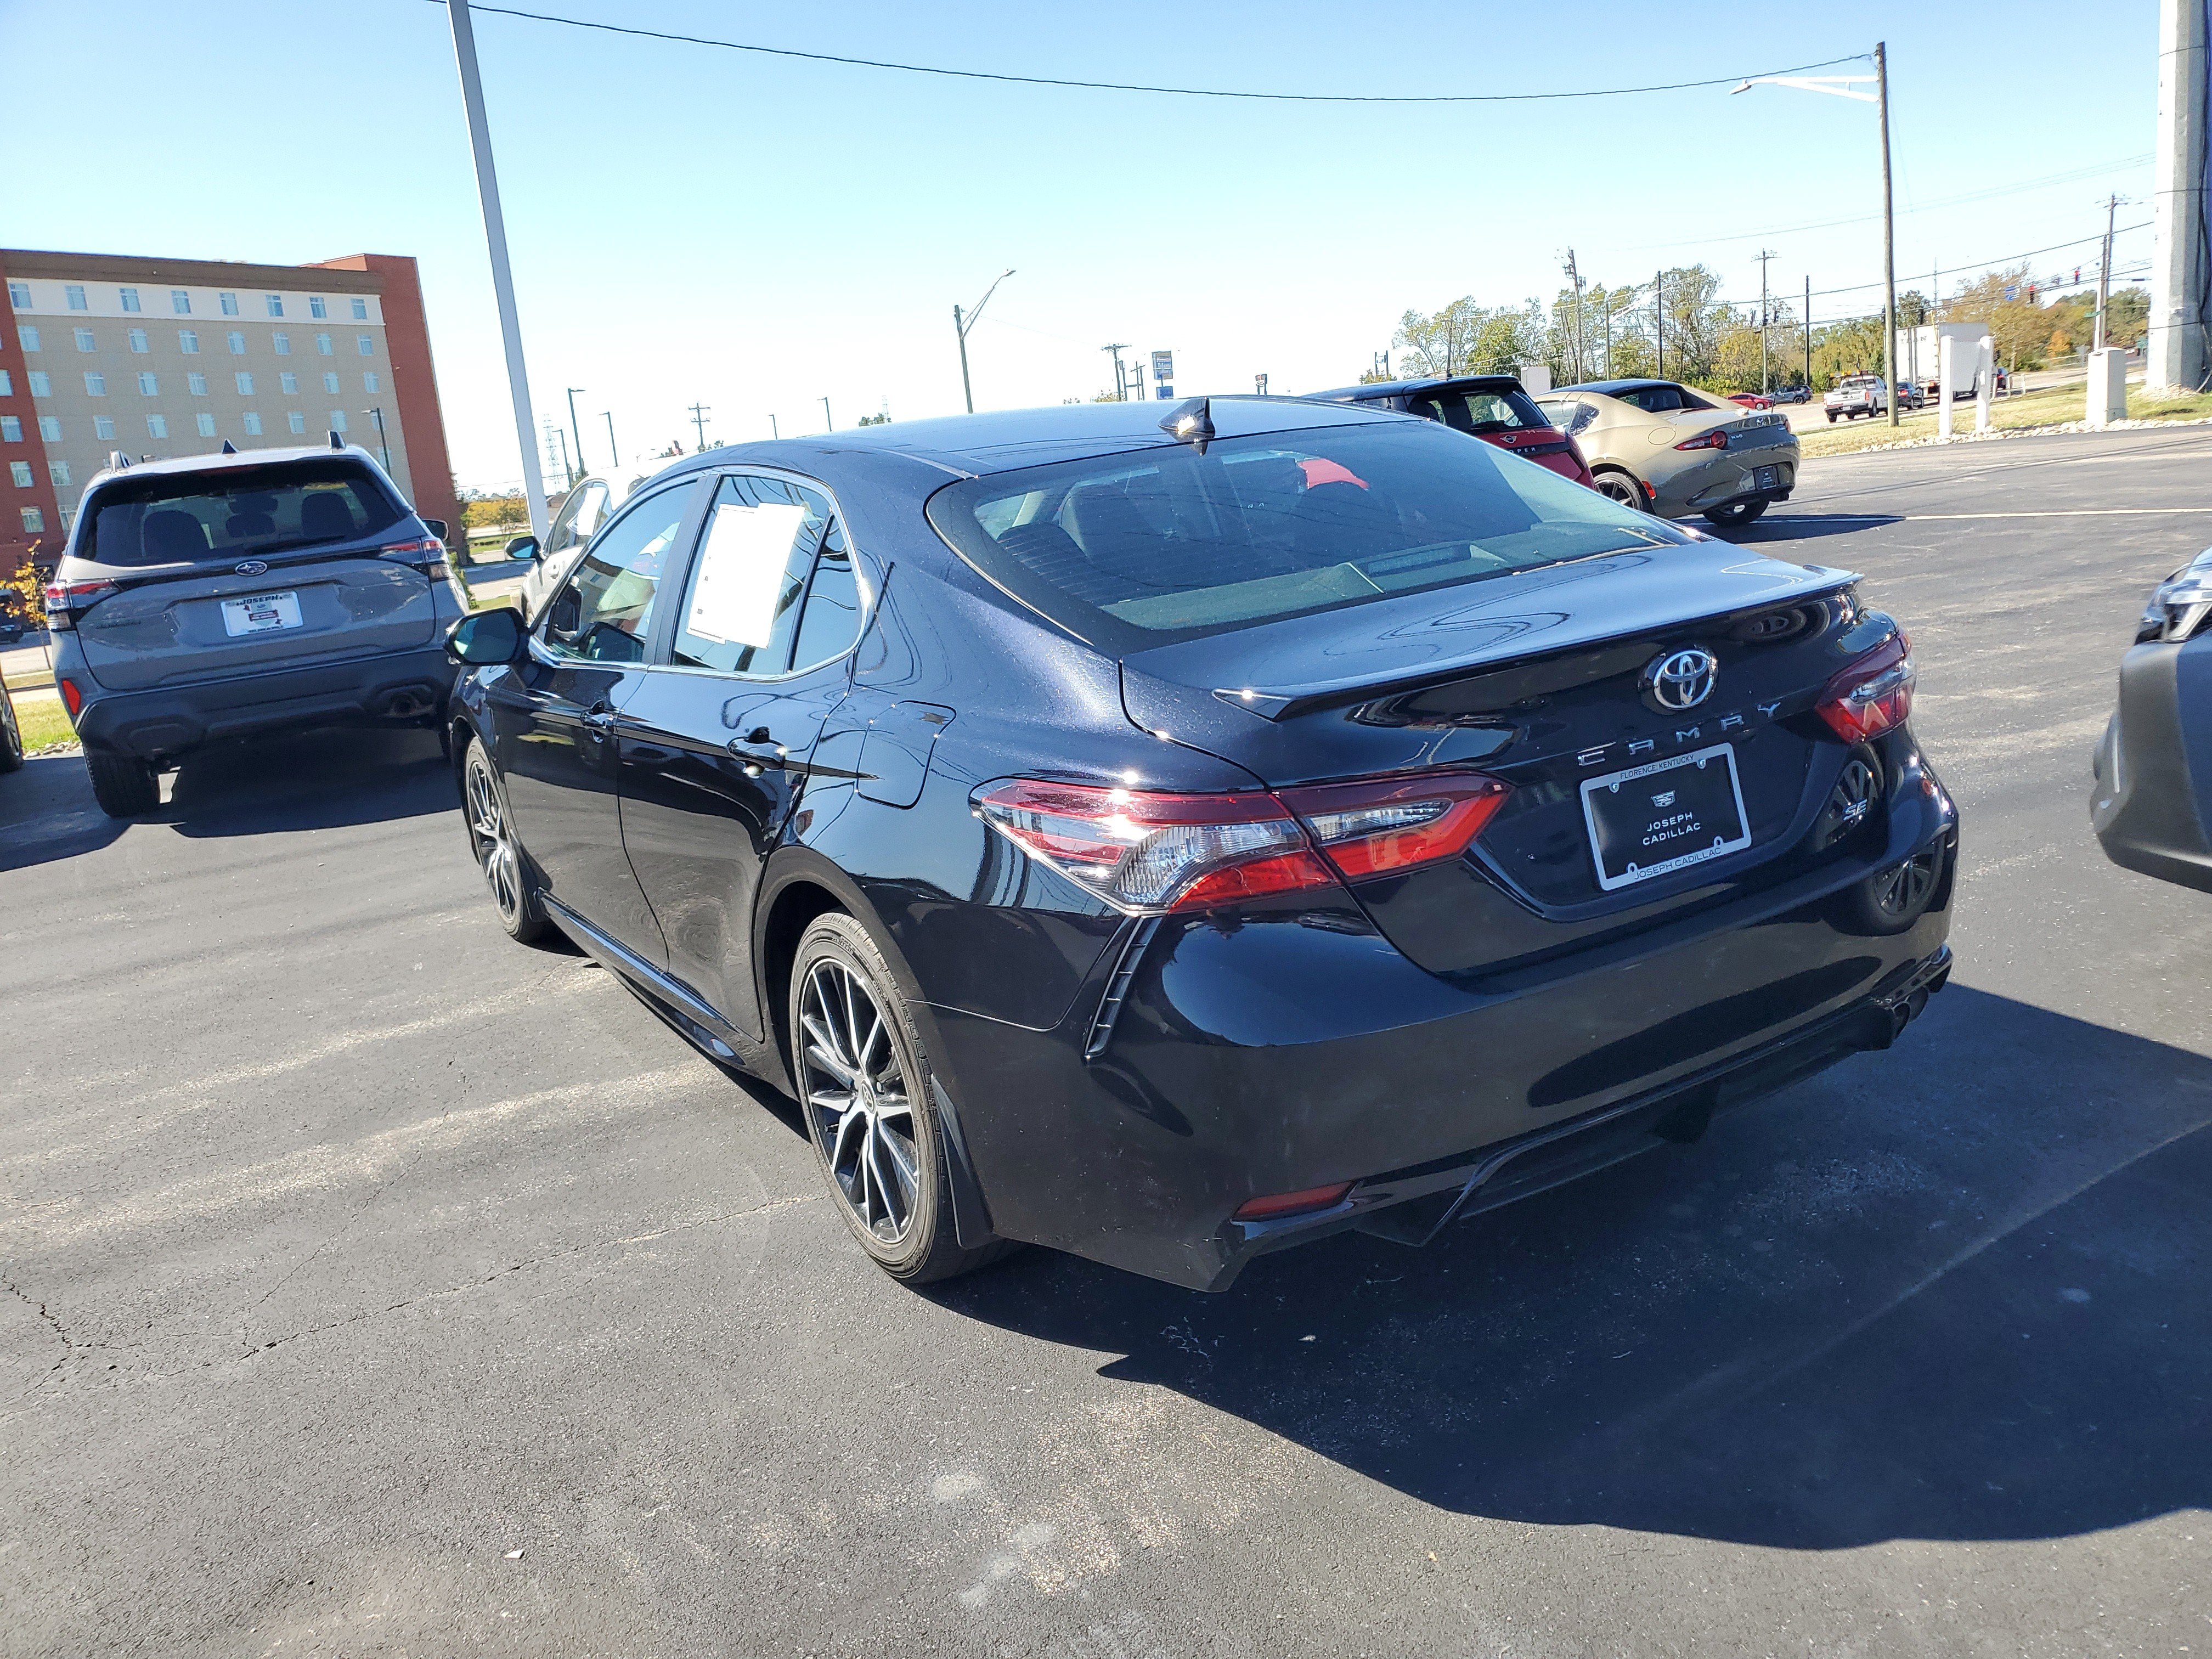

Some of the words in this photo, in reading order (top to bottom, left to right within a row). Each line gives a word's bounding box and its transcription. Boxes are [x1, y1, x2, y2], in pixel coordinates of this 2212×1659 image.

[240, 595, 278, 605] JOSEPH
[1577, 702, 1781, 766] CAMRY
[1658, 754, 1694, 770] KENTUCKY
[1843, 799, 1867, 821] SE
[1646, 811, 1692, 832] JOSEPH
[1643, 822, 1701, 845] CADILLAC
[1634, 861, 1673, 880] JOSEPH
[1674, 847, 1722, 867] CADILLAC
